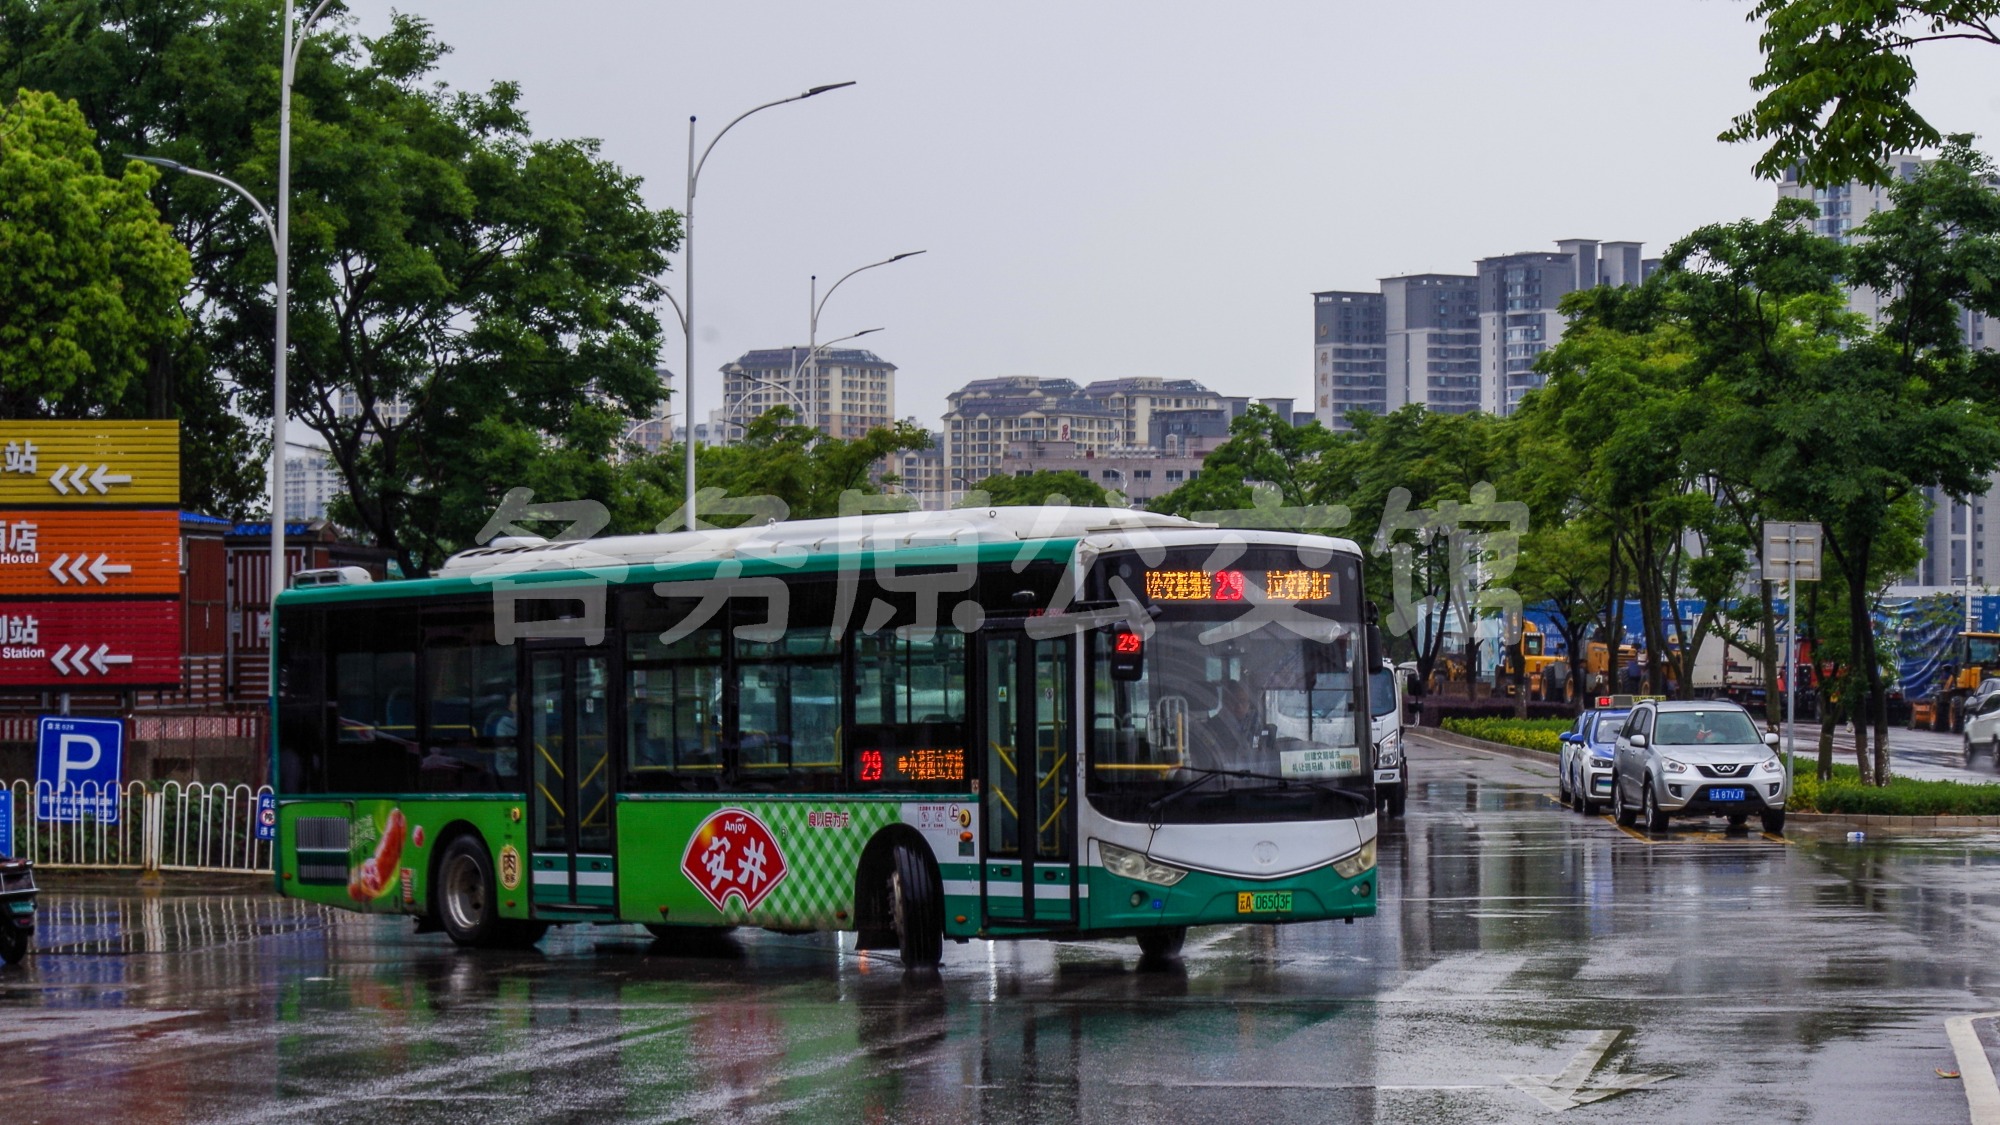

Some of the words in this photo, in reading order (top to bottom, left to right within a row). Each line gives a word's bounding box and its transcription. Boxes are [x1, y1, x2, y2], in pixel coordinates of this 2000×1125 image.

[0, 520, 38, 552] 店
[1, 552, 39, 564] Hotel
[1214, 570, 1244, 601] 29
[2, 646, 46, 659] Station
[1118, 633, 1140, 652] 29
[58, 733, 101, 792] P
[861, 750, 882, 780] 29
[724, 818, 747, 834] Anjoy
[701, 836, 767, 893] 安井
